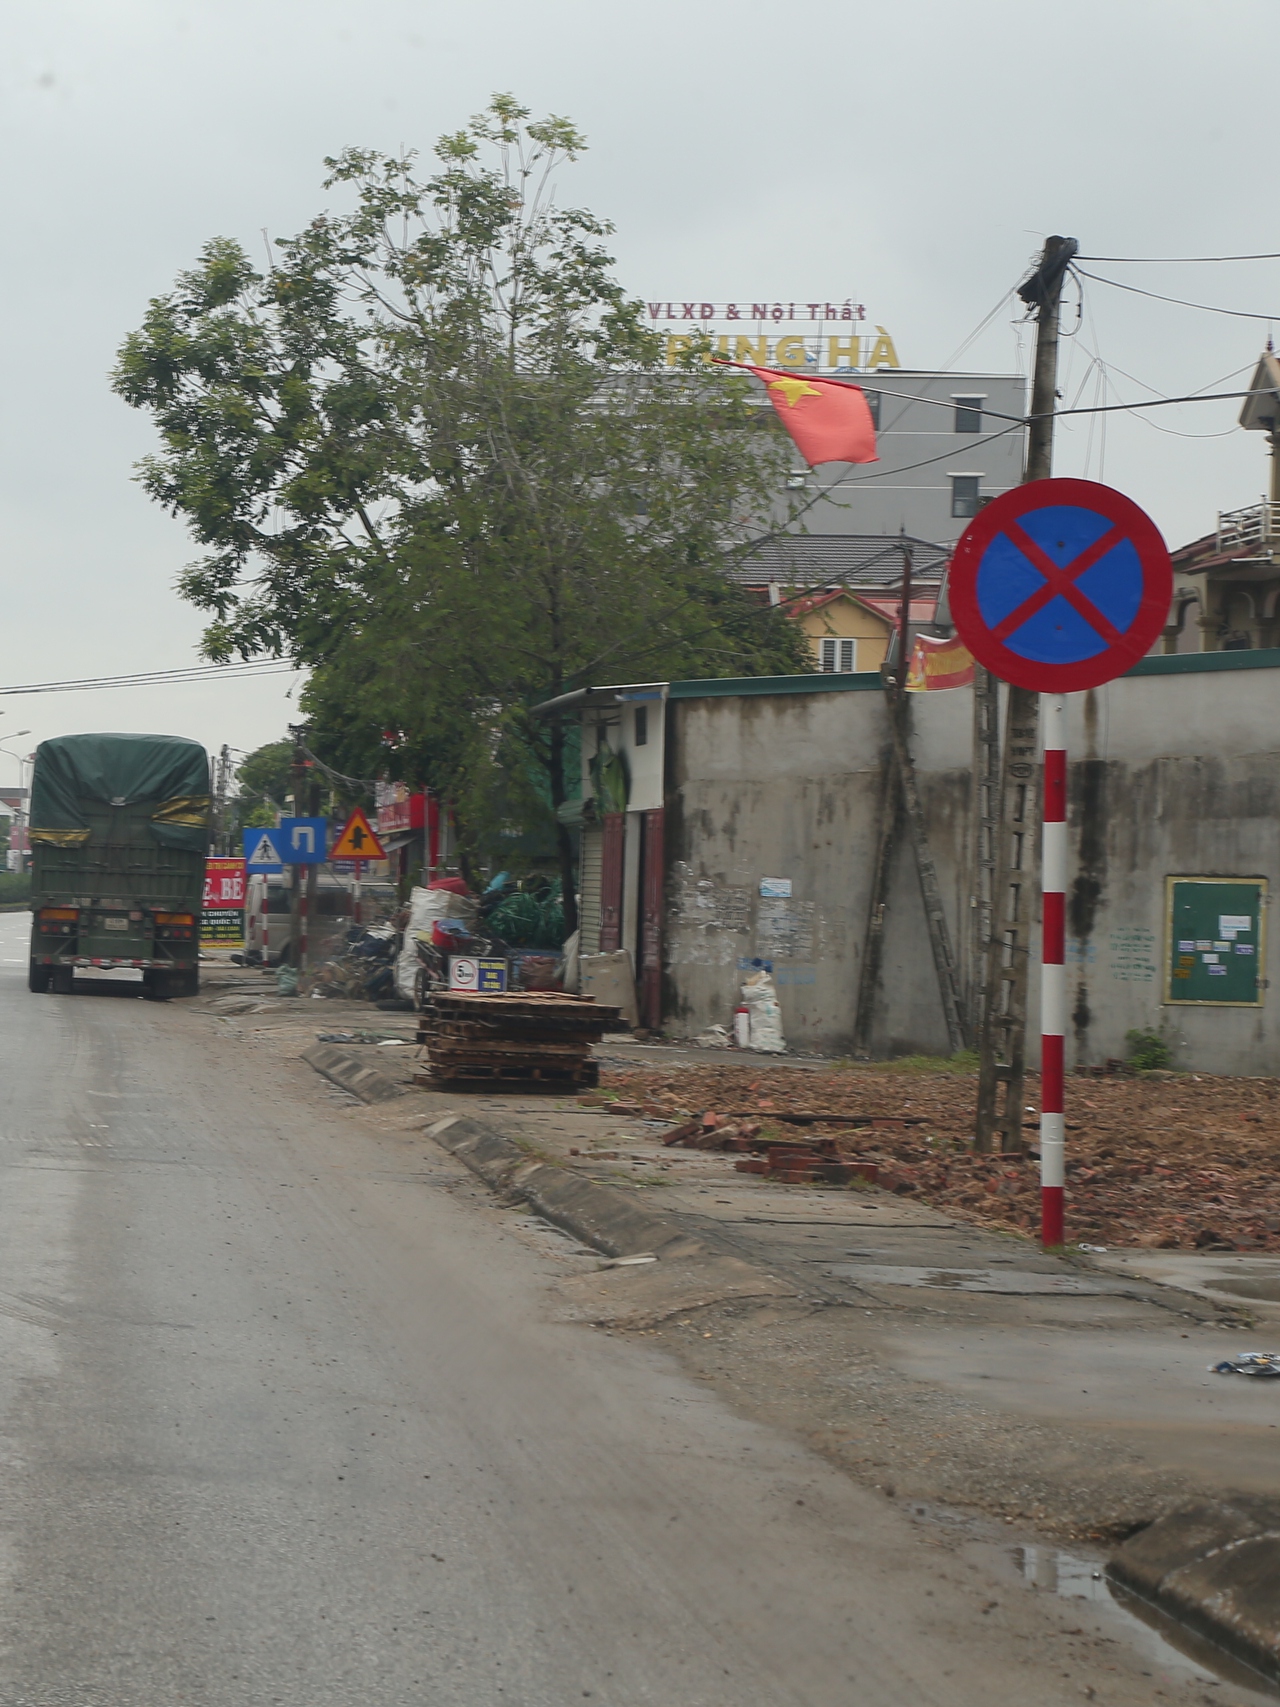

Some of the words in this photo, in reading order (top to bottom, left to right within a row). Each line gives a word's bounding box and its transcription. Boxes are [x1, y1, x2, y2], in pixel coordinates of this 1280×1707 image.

[647, 302, 714, 320] VLXD
[726, 303, 741, 320] &
[752, 302, 794, 324] Nội
[807, 298, 866, 320] Thất
[827, 325, 900, 367] HÀ
[221, 871, 244, 900] BÉ
[457, 965, 465, 978] 5
